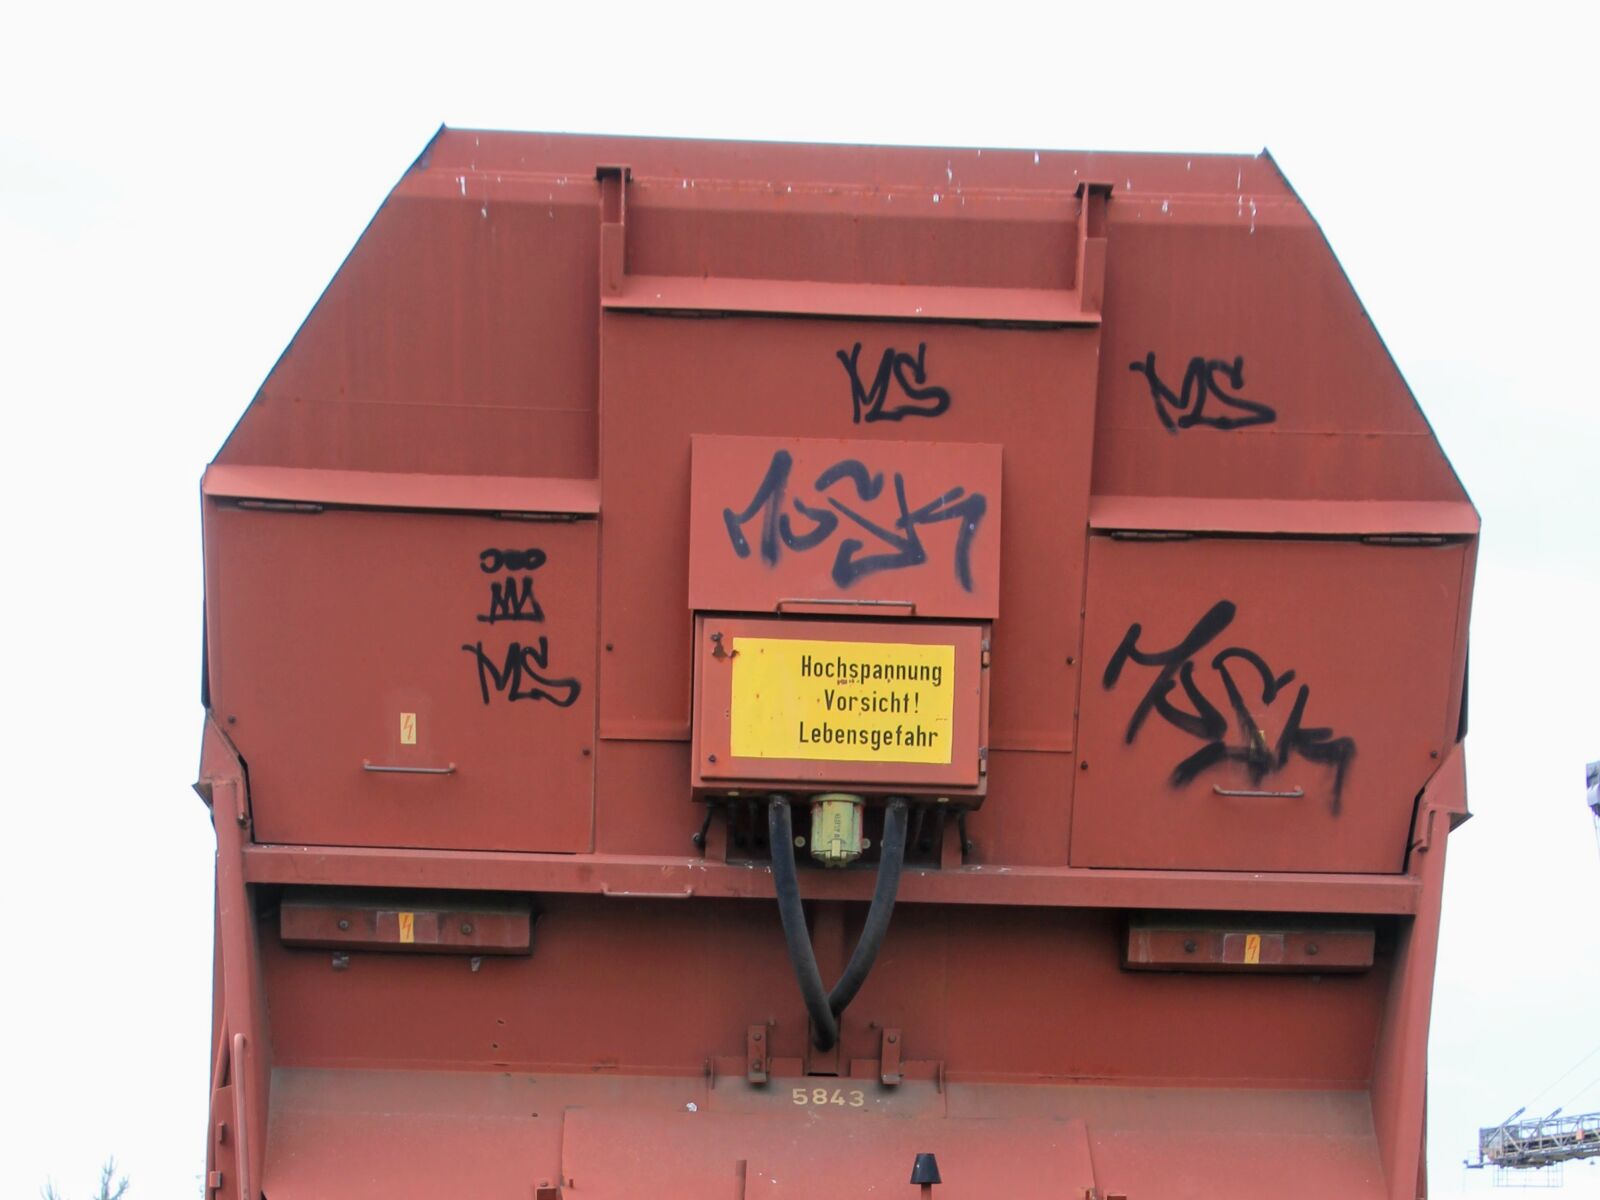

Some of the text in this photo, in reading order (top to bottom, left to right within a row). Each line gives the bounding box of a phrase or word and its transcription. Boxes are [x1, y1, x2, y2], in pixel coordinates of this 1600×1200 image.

[800, 655, 943, 687] Hochspannung
[823, 688, 920, 714] Vorsicht!
[798, 721, 939, 751] Lebensgefahr
[791, 1088, 866, 1108] 5843
